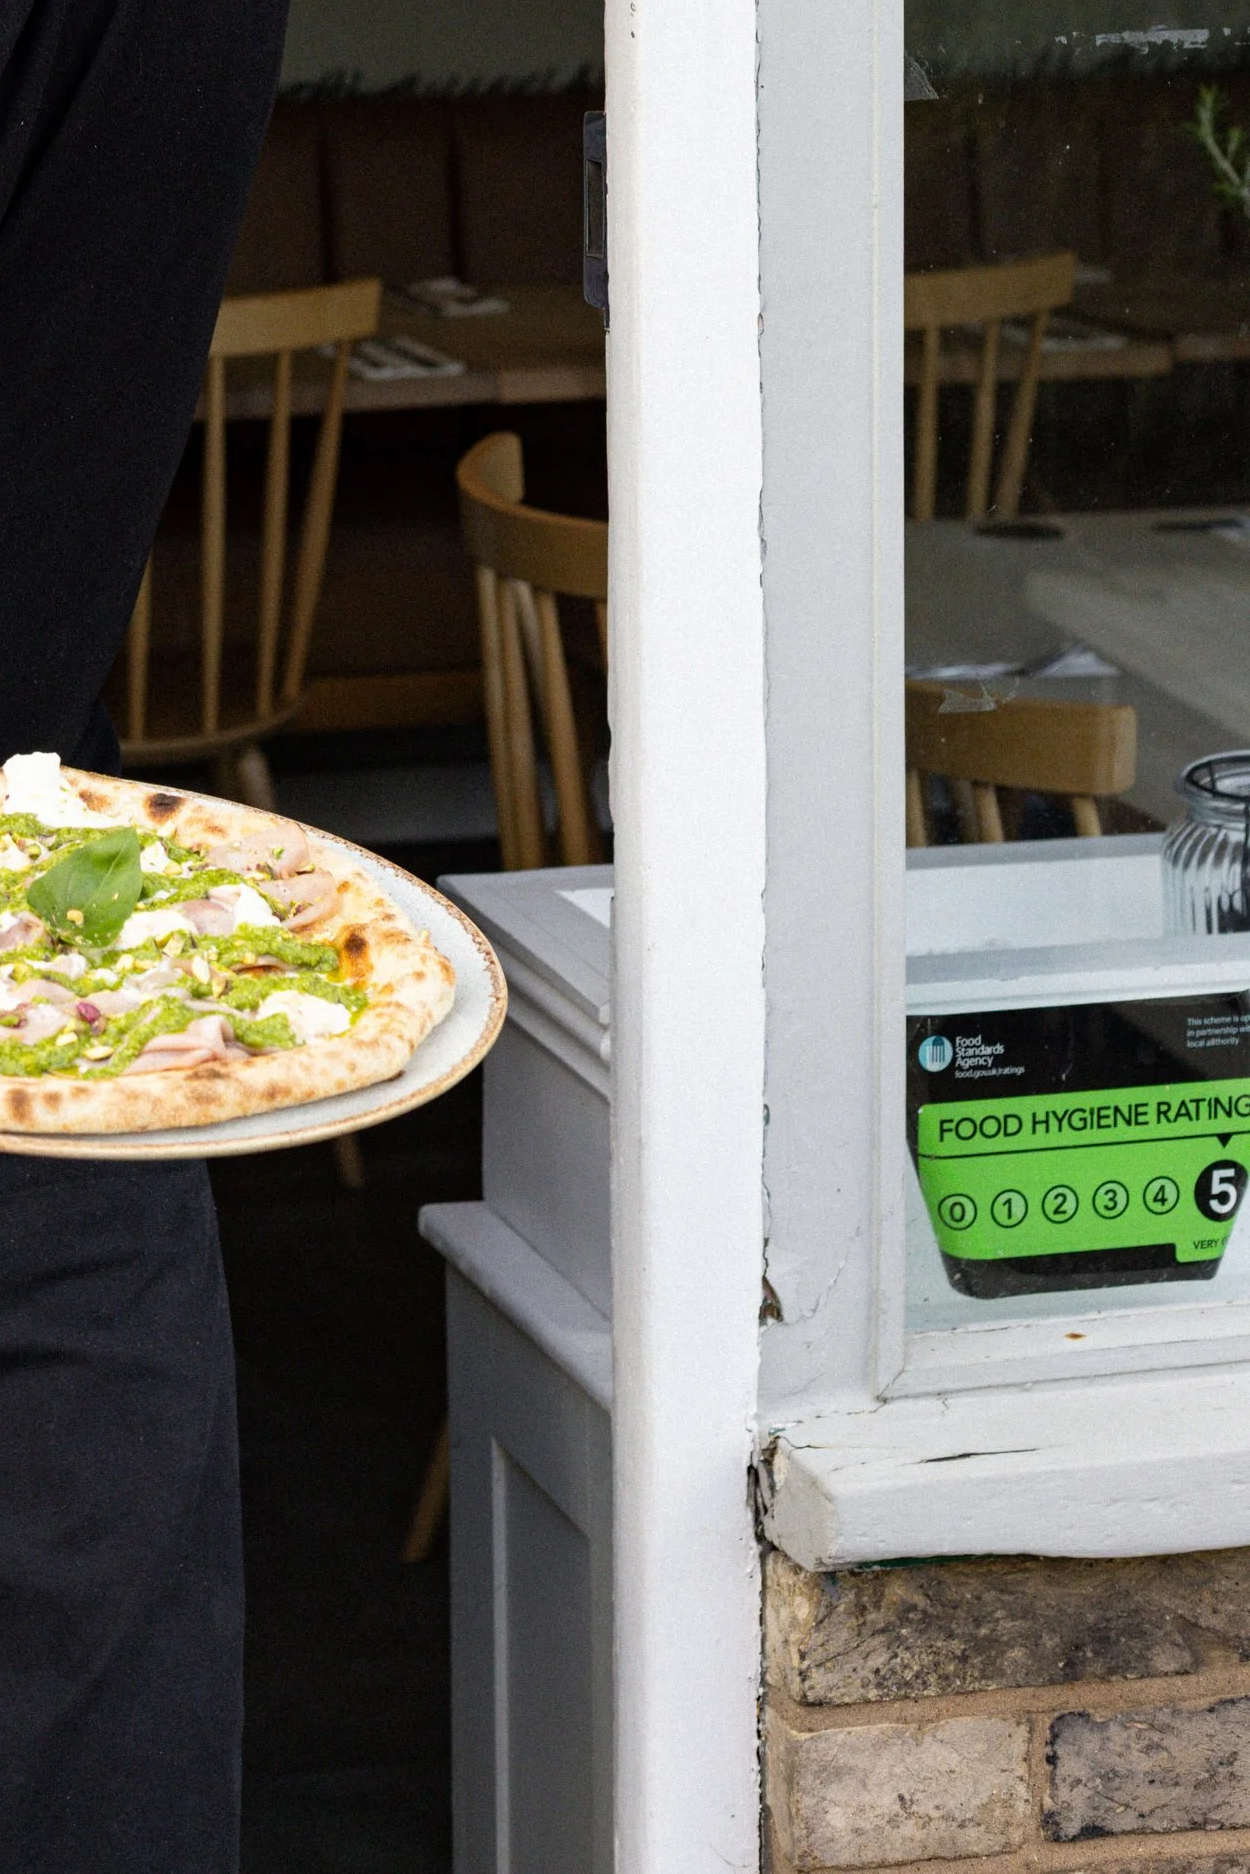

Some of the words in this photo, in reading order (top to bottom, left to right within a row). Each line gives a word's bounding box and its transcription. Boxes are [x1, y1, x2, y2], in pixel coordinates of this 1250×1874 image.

[955, 1034, 982, 1047] Food
[955, 1043, 1004, 1057] Standards
[955, 1056, 994, 1069] Agency
[939, 1113, 1023, 1142] FOOD
[1031, 1102, 1150, 1135] HYGIENE
[1156, 1094, 1250, 1125] RATING
[950, 1201, 966, 1223] 0
[1002, 1197, 1013, 1220] 1
[1053, 1192, 1068, 1216] 2
[1103, 1188, 1118, 1211] 3
[1153, 1184, 1168, 1207] 4
[1209, 1168, 1238, 1215] 5
[1193, 1238, 1220, 1250] VERY
